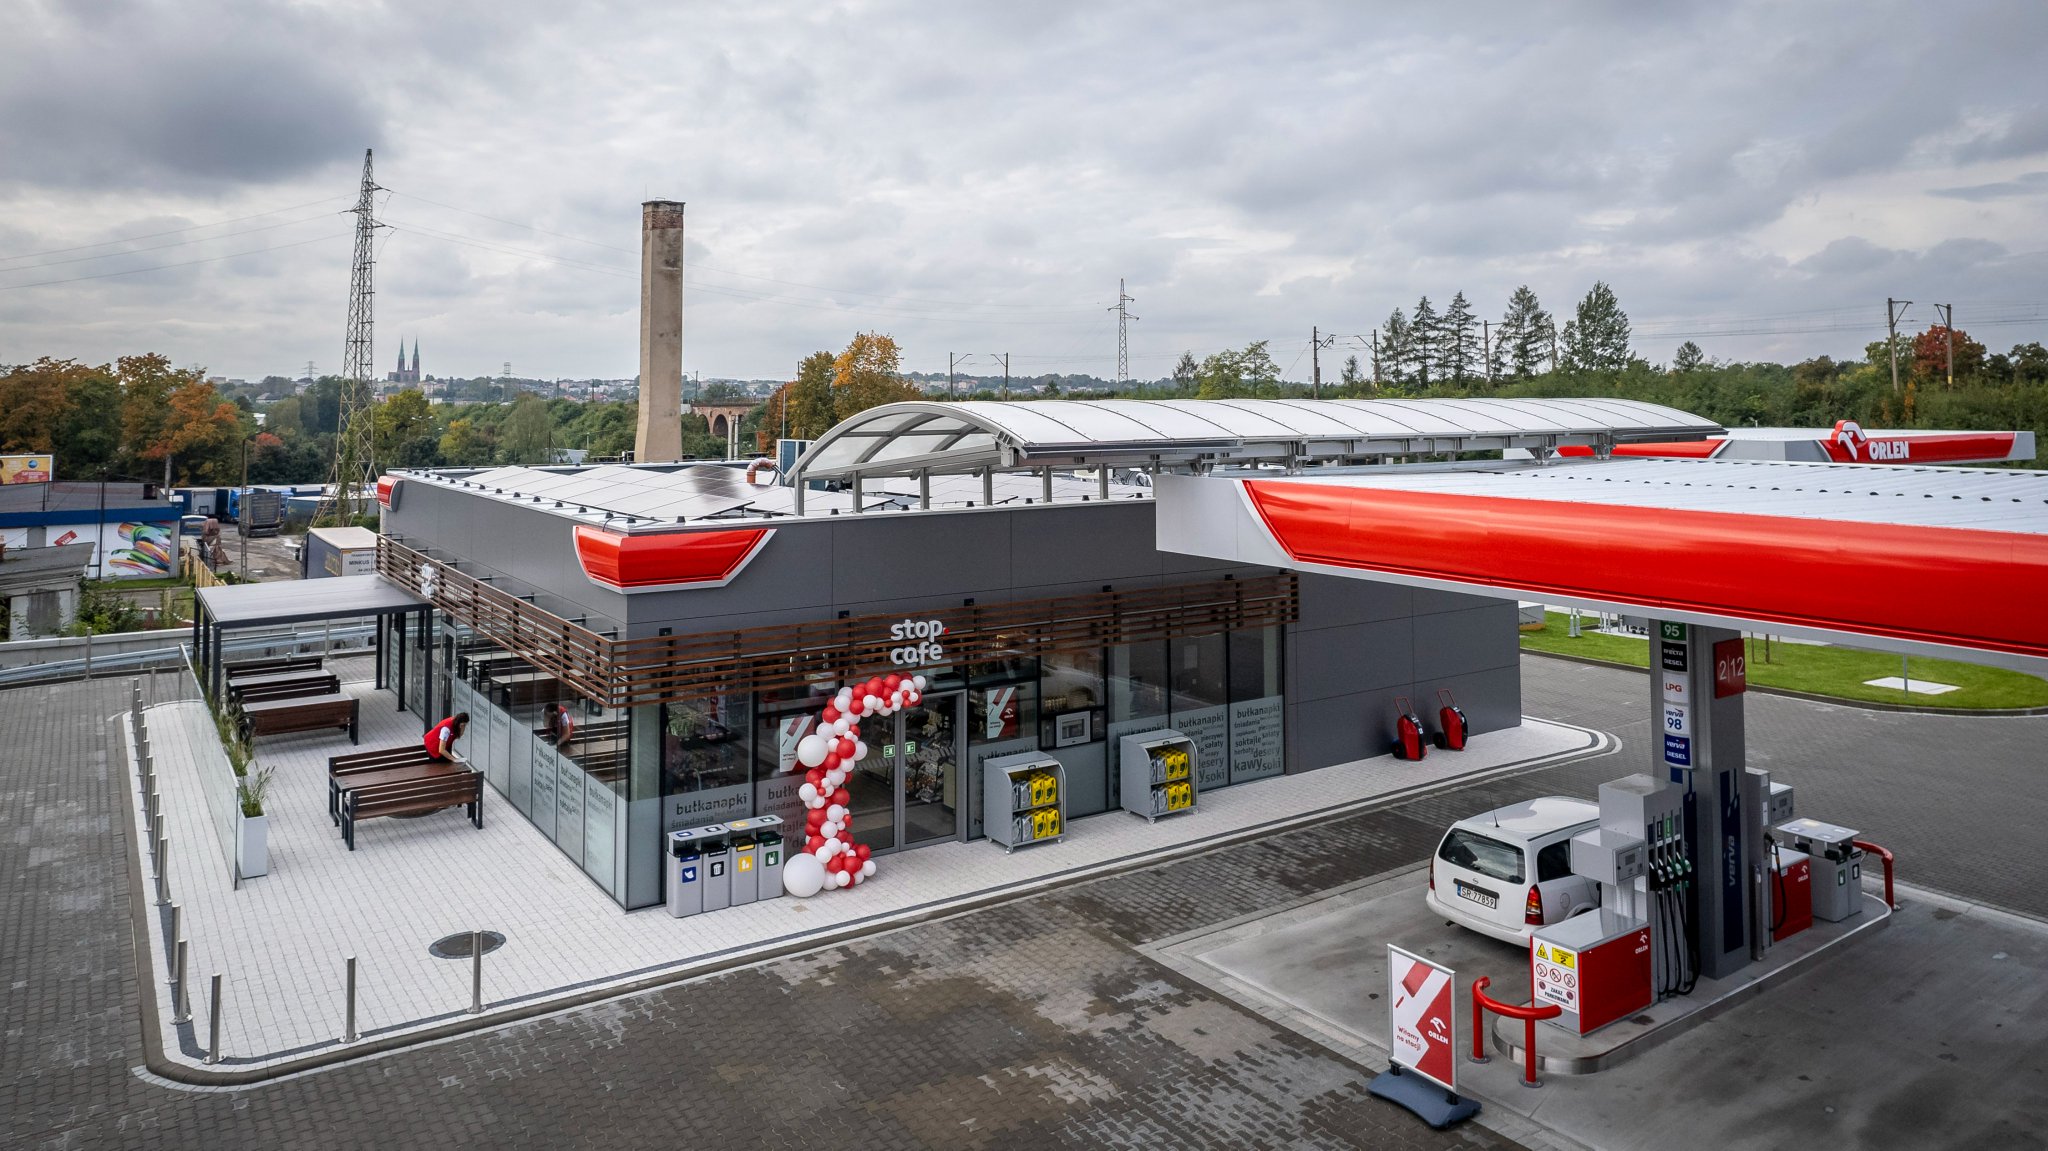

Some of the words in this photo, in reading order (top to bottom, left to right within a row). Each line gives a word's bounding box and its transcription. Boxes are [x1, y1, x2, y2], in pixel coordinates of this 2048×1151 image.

[1869, 441, 1909, 460] ORLEN
[1664, 624, 1680, 637] 95
[890, 641, 943, 665] cafe
[1663, 658, 1684, 667] DIESEL
[1665, 682, 1682, 693] LPG
[1178, 711, 1224, 729] bułkanapki
[1665, 708, 1684, 718] verva
[1667, 717, 1682, 730] 98
[1666, 740, 1685, 750] verva
[1666, 750, 1687, 760] DIESEL
[1234, 758, 1262, 773] kawy
[1262, 757, 1281, 771] soki
[1205, 769, 1225, 783] soki
[676, 793, 747, 816] bułkanapki
[671, 814, 714, 829] śniadania
[1728, 835, 1736, 887] verva
[1461, 886, 1472, 898] SR
[1473, 891, 1494, 907] 77859
[1635, 945, 1648, 954] ORLEN
[1398, 1025, 1419, 1043] Witamy
[1427, 1030, 1449, 1045] ORLEN
[1396, 1034, 1404, 1042] na
[1405, 1038, 1421, 1052] stacji
